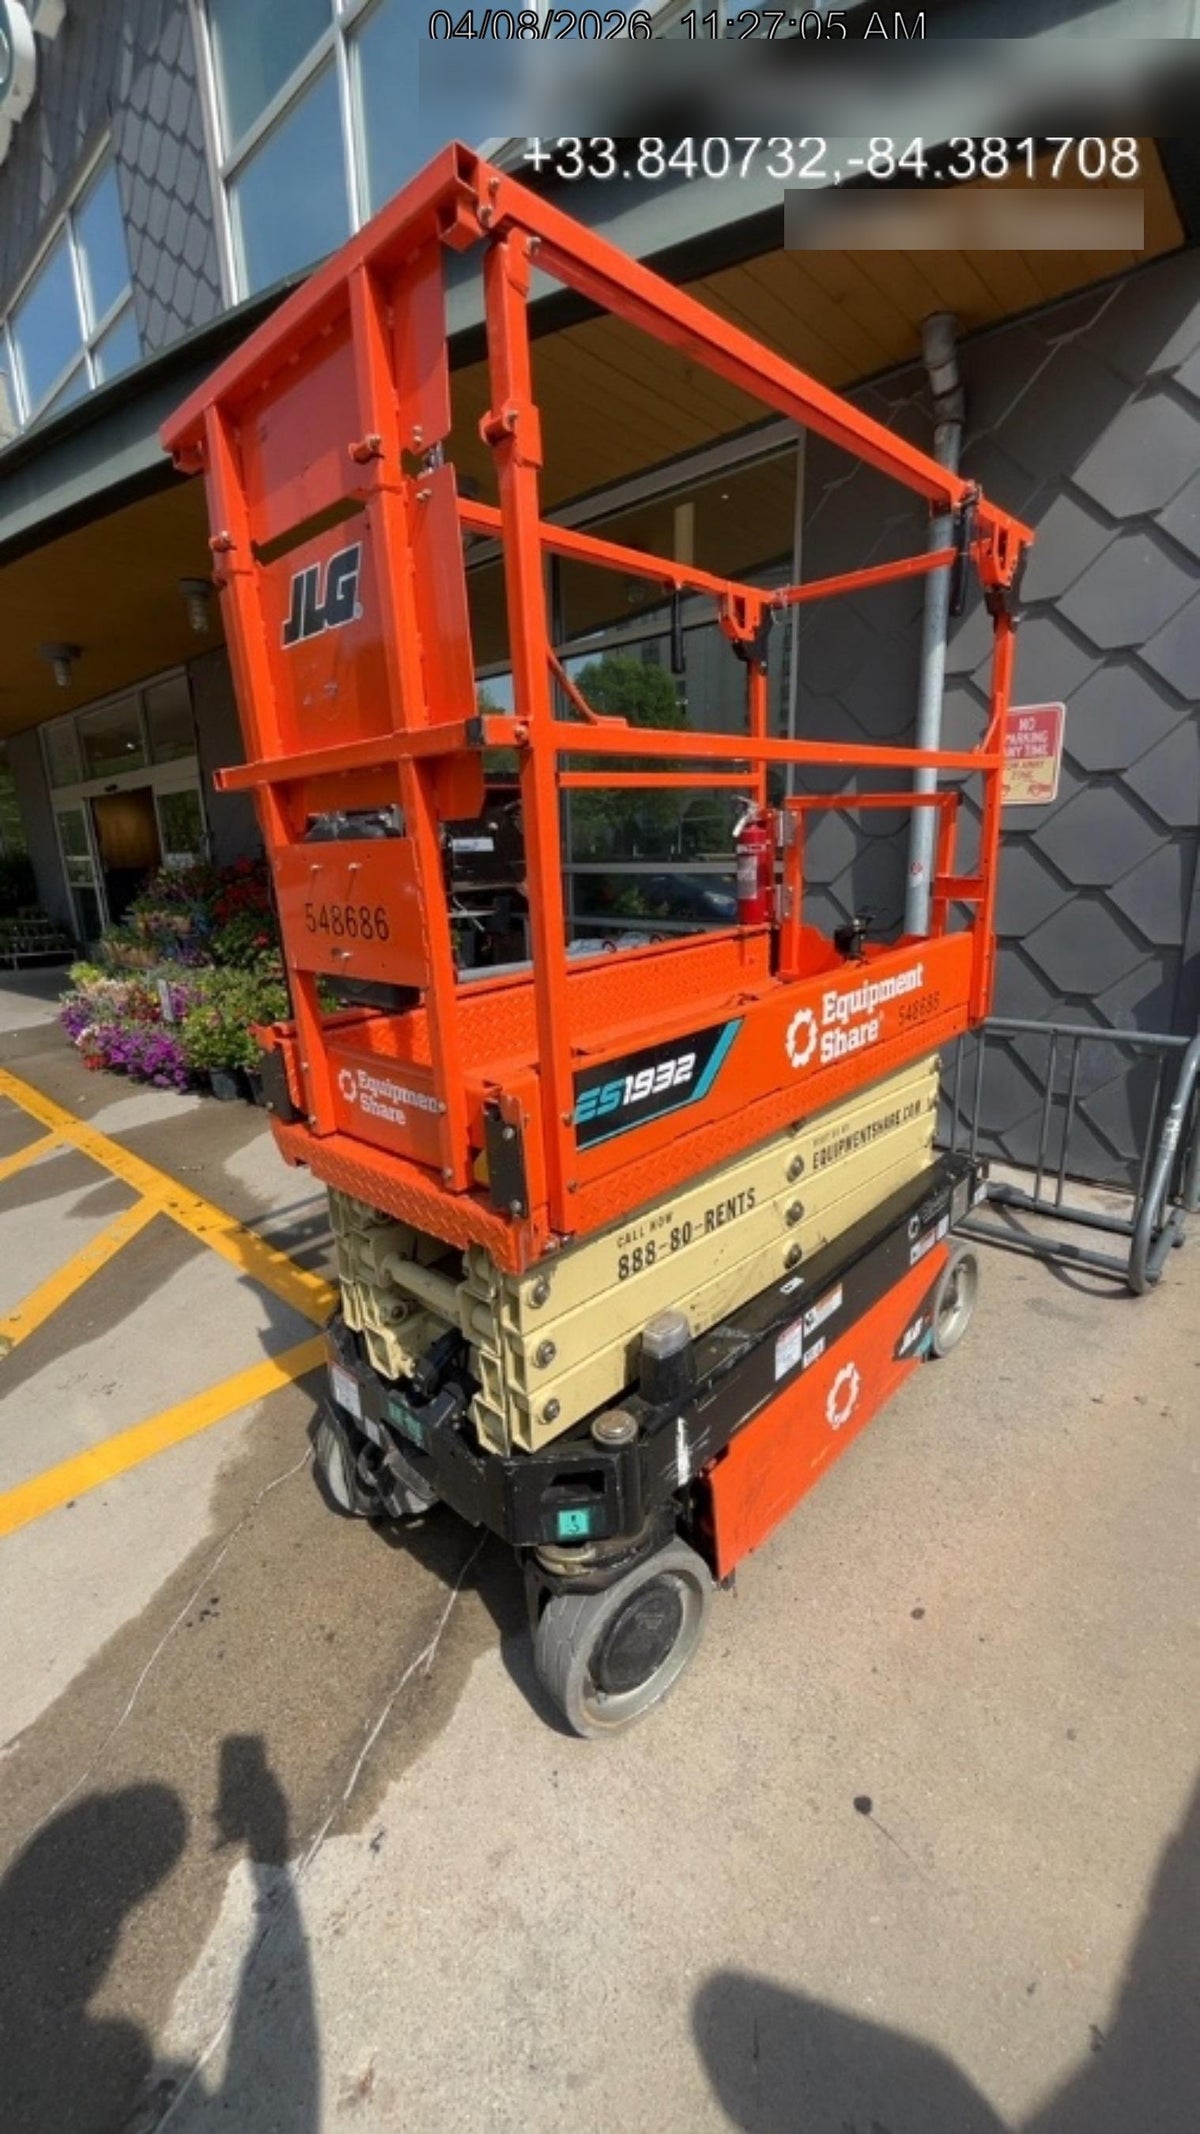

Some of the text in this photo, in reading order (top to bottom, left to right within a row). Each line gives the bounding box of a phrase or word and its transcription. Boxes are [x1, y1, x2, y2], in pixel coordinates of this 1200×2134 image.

[281, 541, 362, 650] JLG
[1019, 716, 1037, 732] NO
[304, 902, 390, 941] 548686
[821, 961, 924, 1024] Equipment
[819, 1016, 880, 1064] Share
[357, 1068, 440, 1113] Equipmen
[360, 1091, 407, 1126] Share
[573, 1052, 696, 1125] ES1932
[616, 1210, 674, 1248] CALL NOW
[617, 1187, 756, 1281] 888-80-RENTS
